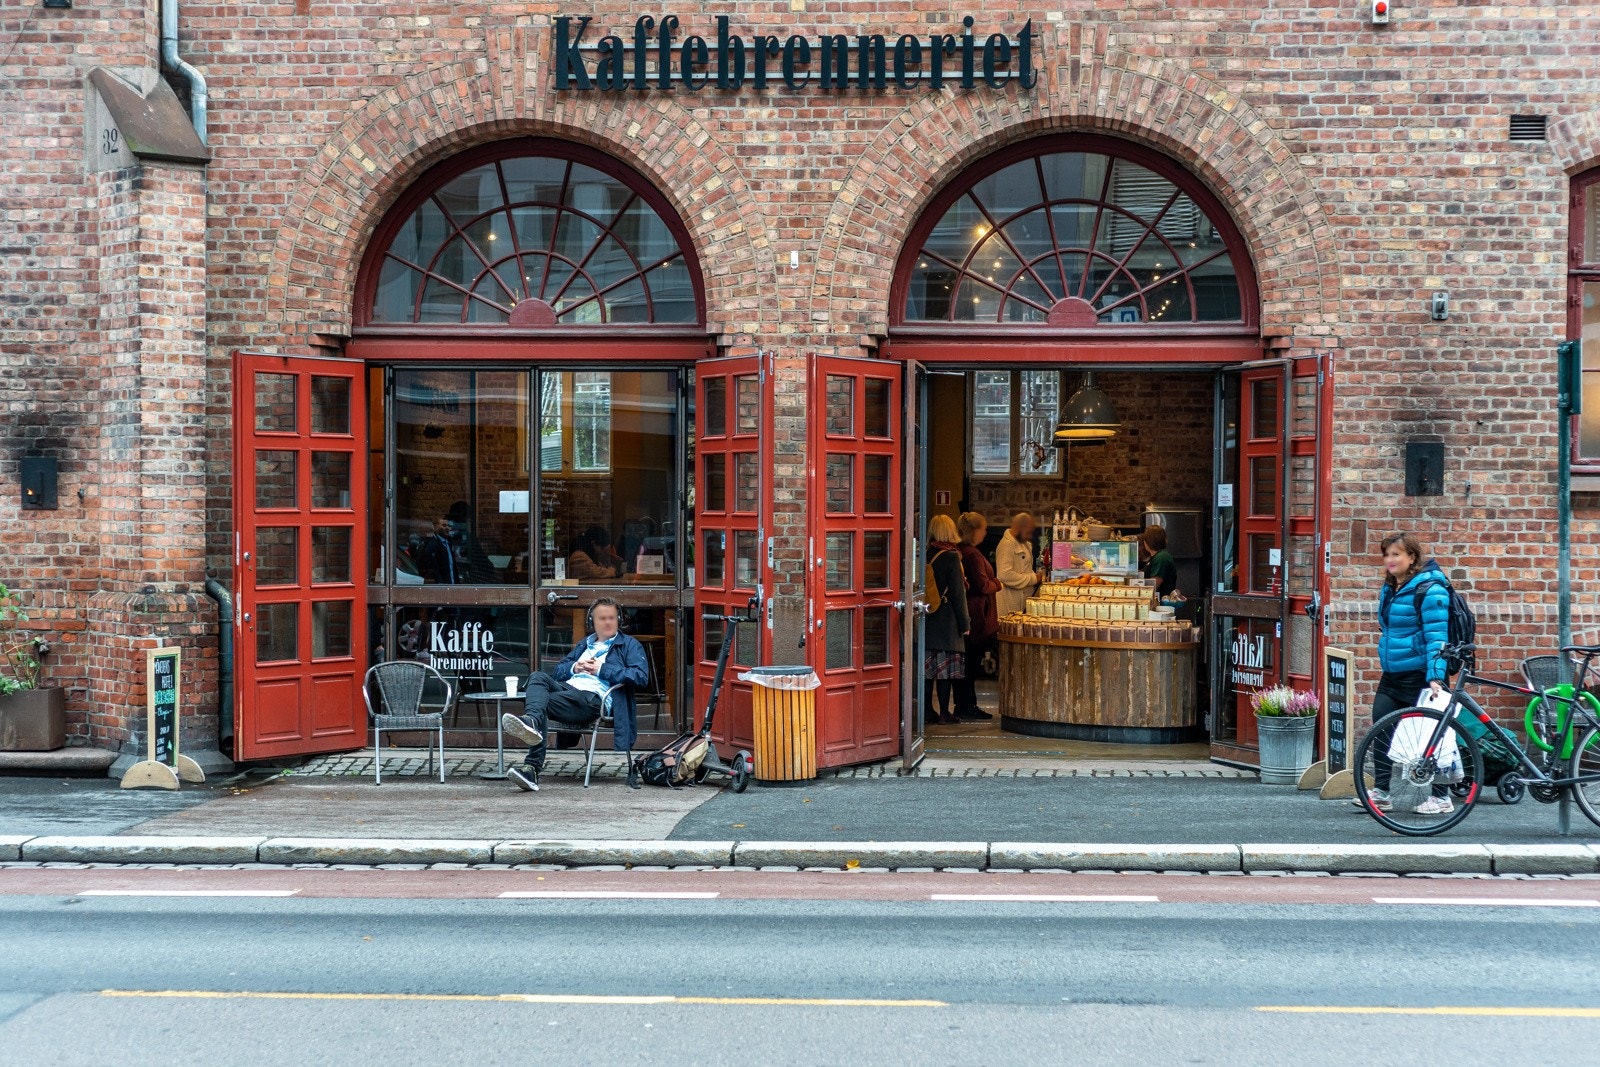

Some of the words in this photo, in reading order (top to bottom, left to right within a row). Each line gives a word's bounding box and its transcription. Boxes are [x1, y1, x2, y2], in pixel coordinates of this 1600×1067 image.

[552, 15, 1037, 91] Kaffebrenneriet
[103, 128, 119, 155] 32
[430, 621, 494, 653] Kaffe
[430, 654, 494, 671] brenneriet
